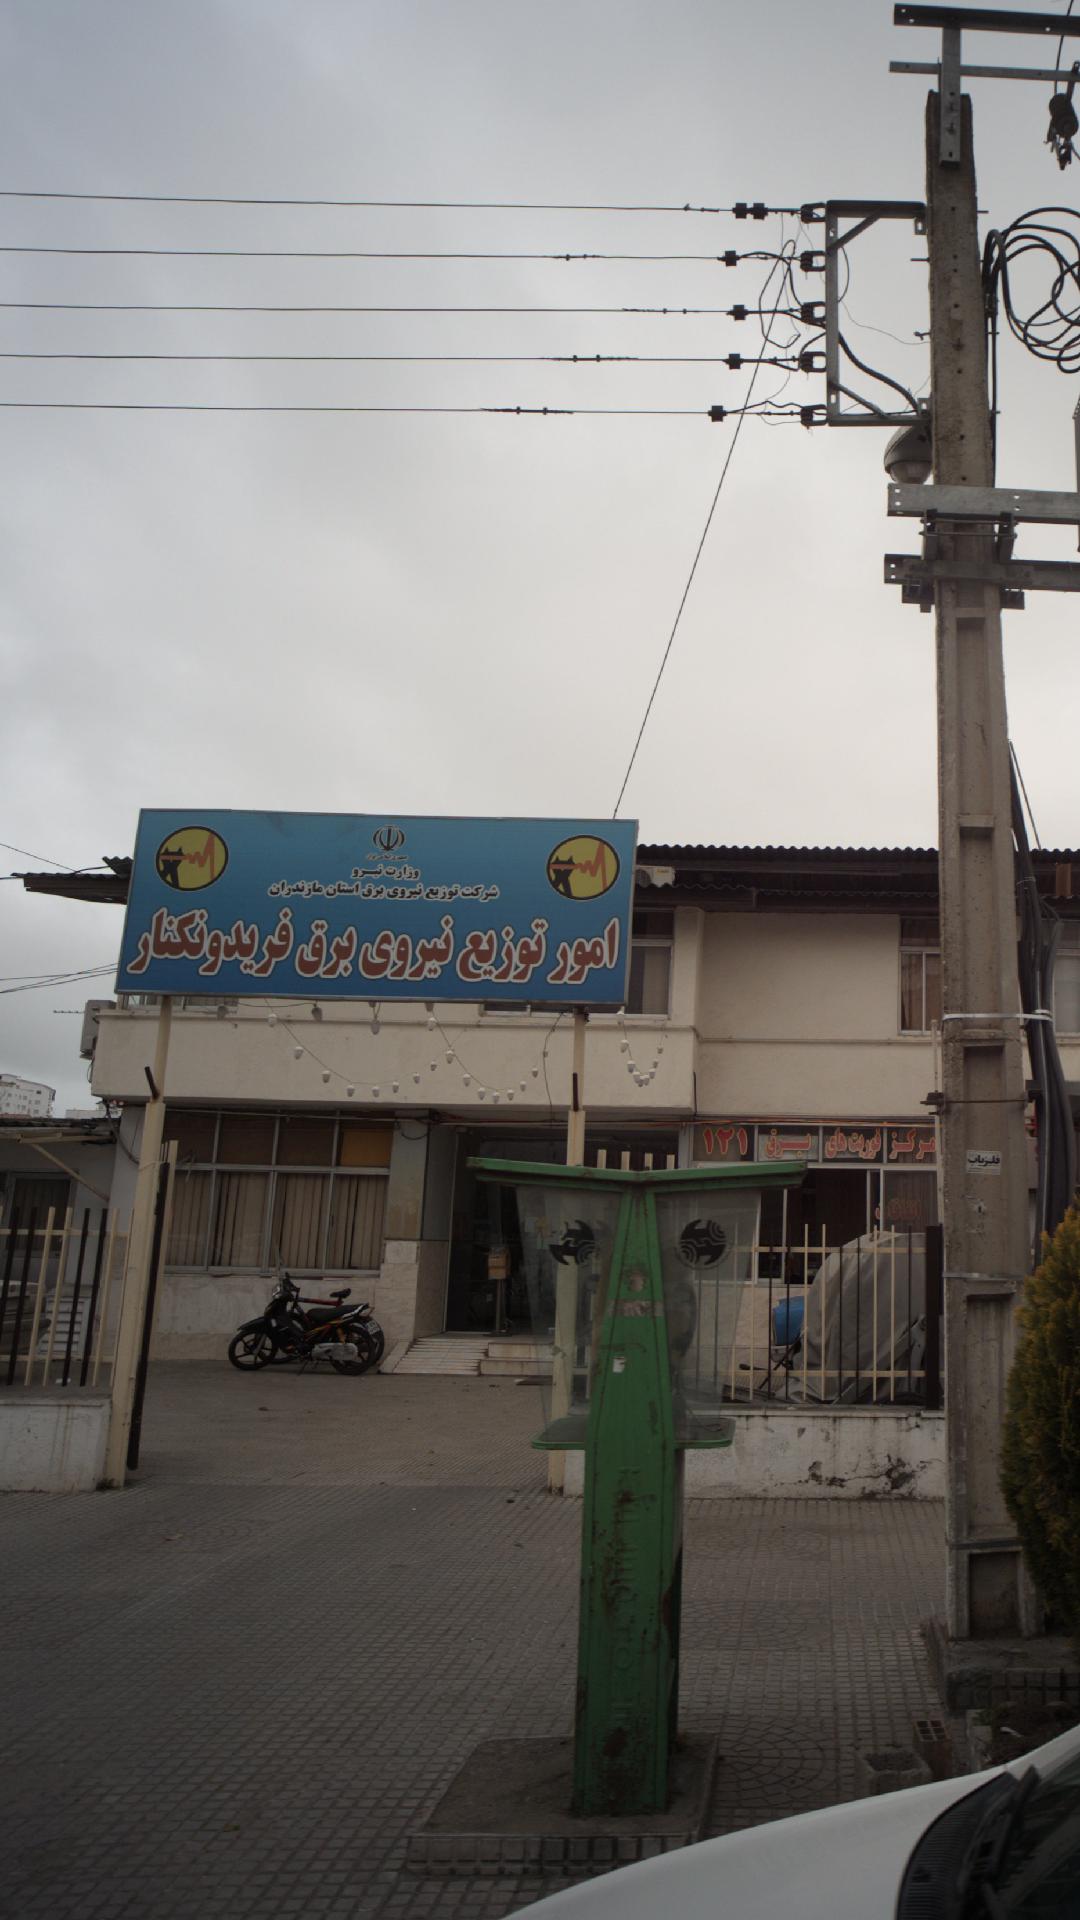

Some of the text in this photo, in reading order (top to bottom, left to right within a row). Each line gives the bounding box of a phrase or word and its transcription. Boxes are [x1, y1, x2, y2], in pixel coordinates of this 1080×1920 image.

[351, 863, 420, 880] وزارت نیرو
[268, 880, 500, 901] شرکت توزیع نیروی برق استان مازندران
[127, 905, 621, 984] امور توزیع نیروی برق فریدونکنار
